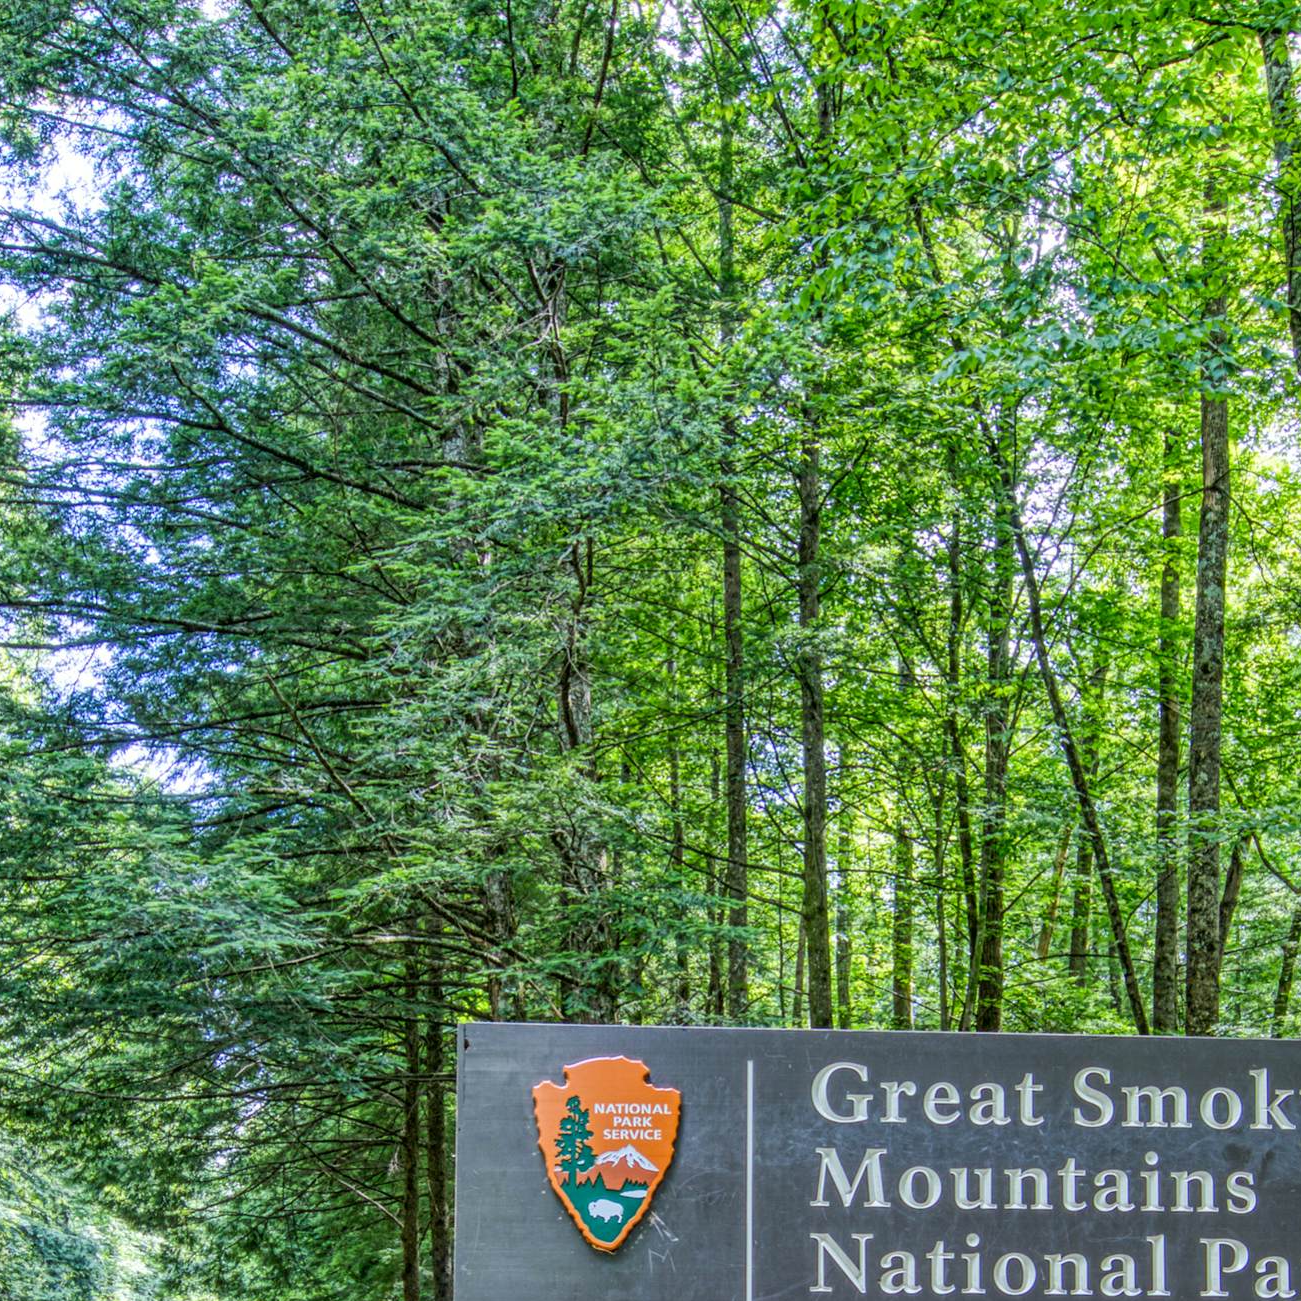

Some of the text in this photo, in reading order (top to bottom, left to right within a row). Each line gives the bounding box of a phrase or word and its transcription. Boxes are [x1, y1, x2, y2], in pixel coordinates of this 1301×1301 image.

[593, 1103, 672, 1115] NATIONAL
[810, 1061, 1046, 1127] Great
[602, 1128, 662, 1141] SERVICE
[612, 1115, 652, 1128] PARK
[808, 1145, 1258, 1215] Mountains
[808, 1231, 1173, 1298] National
